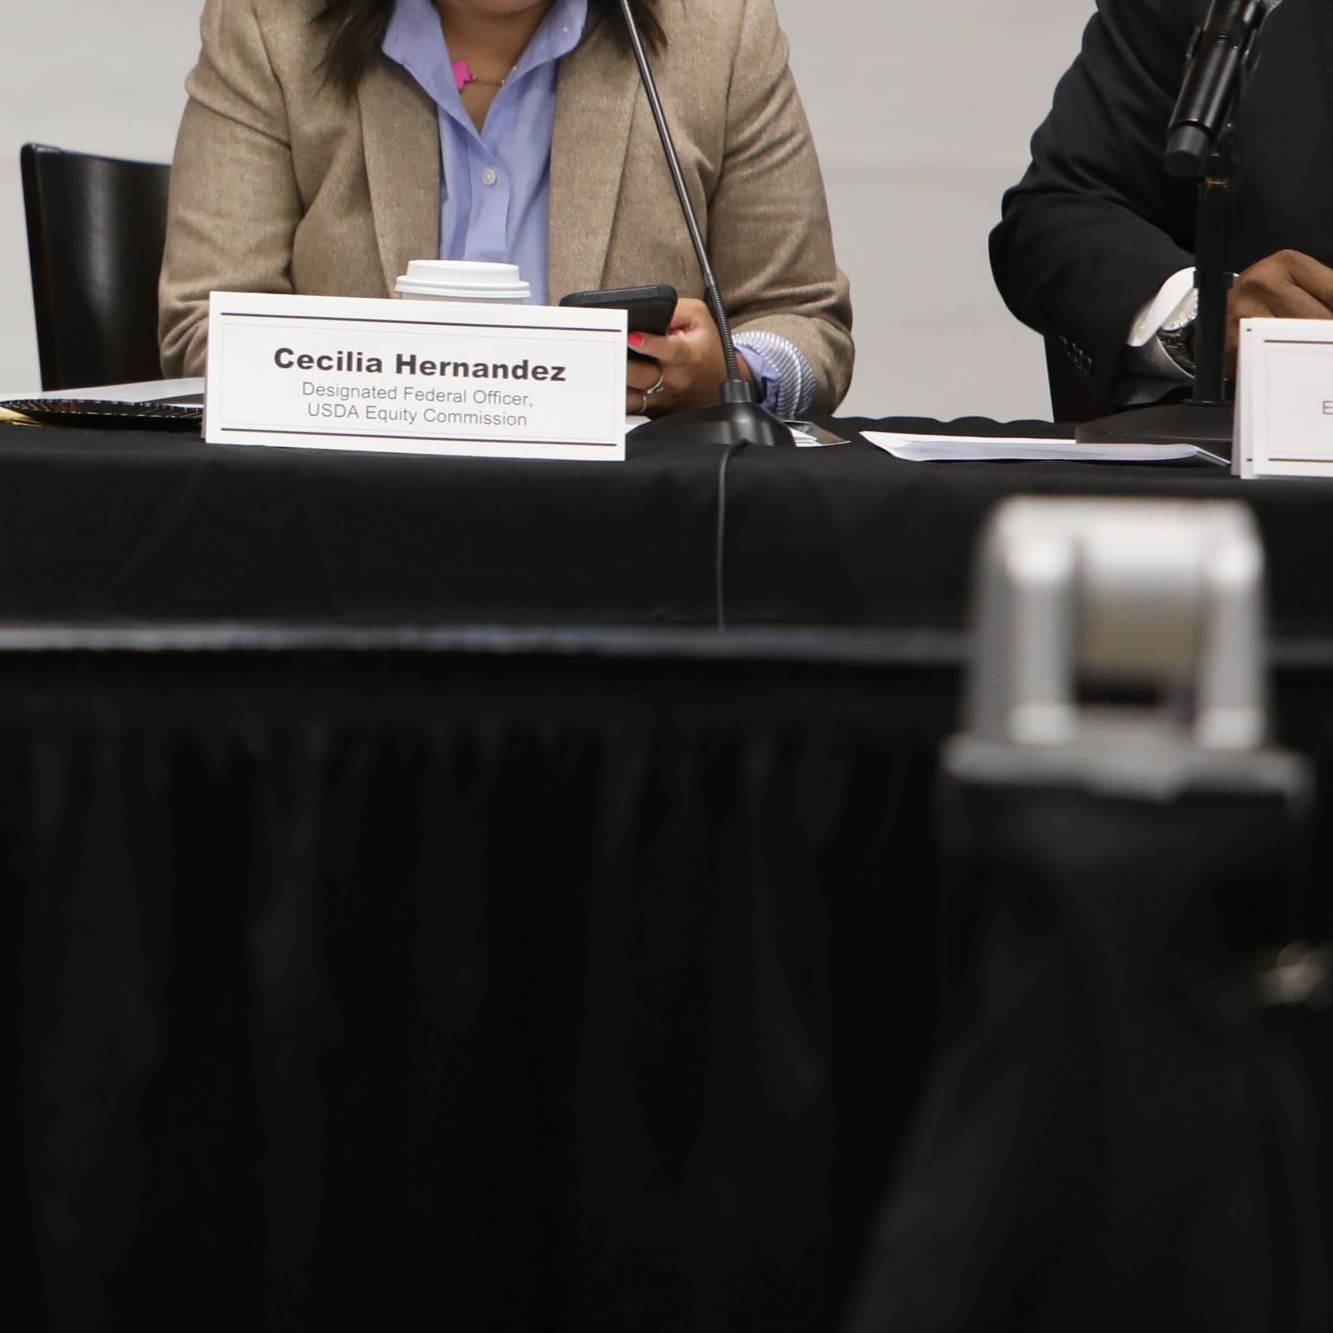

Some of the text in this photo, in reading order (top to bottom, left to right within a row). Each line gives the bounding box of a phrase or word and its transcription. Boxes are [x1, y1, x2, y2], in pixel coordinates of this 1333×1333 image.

[273, 346, 567, 382] Cecilia Hernandez
[302, 381, 533, 408] Designated Federal Officer,
[307, 402, 527, 427] USDA Equity Commission
